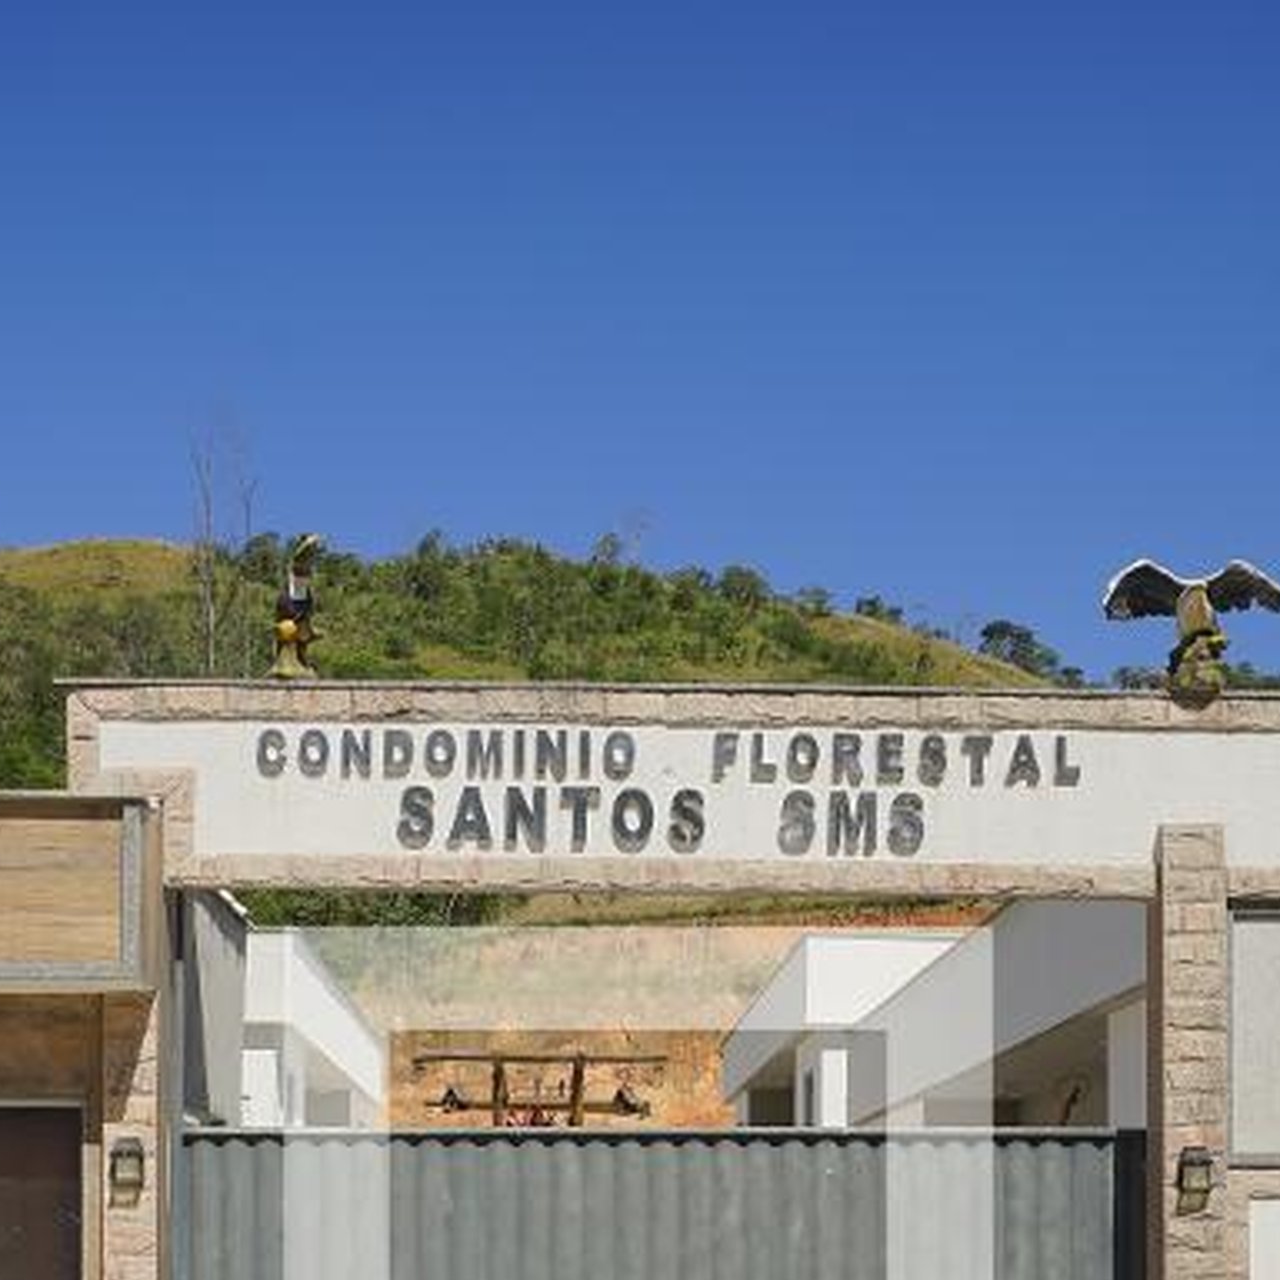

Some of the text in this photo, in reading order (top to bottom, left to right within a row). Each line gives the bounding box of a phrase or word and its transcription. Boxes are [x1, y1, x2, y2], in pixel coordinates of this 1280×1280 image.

[256, 728, 1081, 788] CONDOMINIO FLORESTAL
[396, 785, 925, 857] SANTOS SMS
